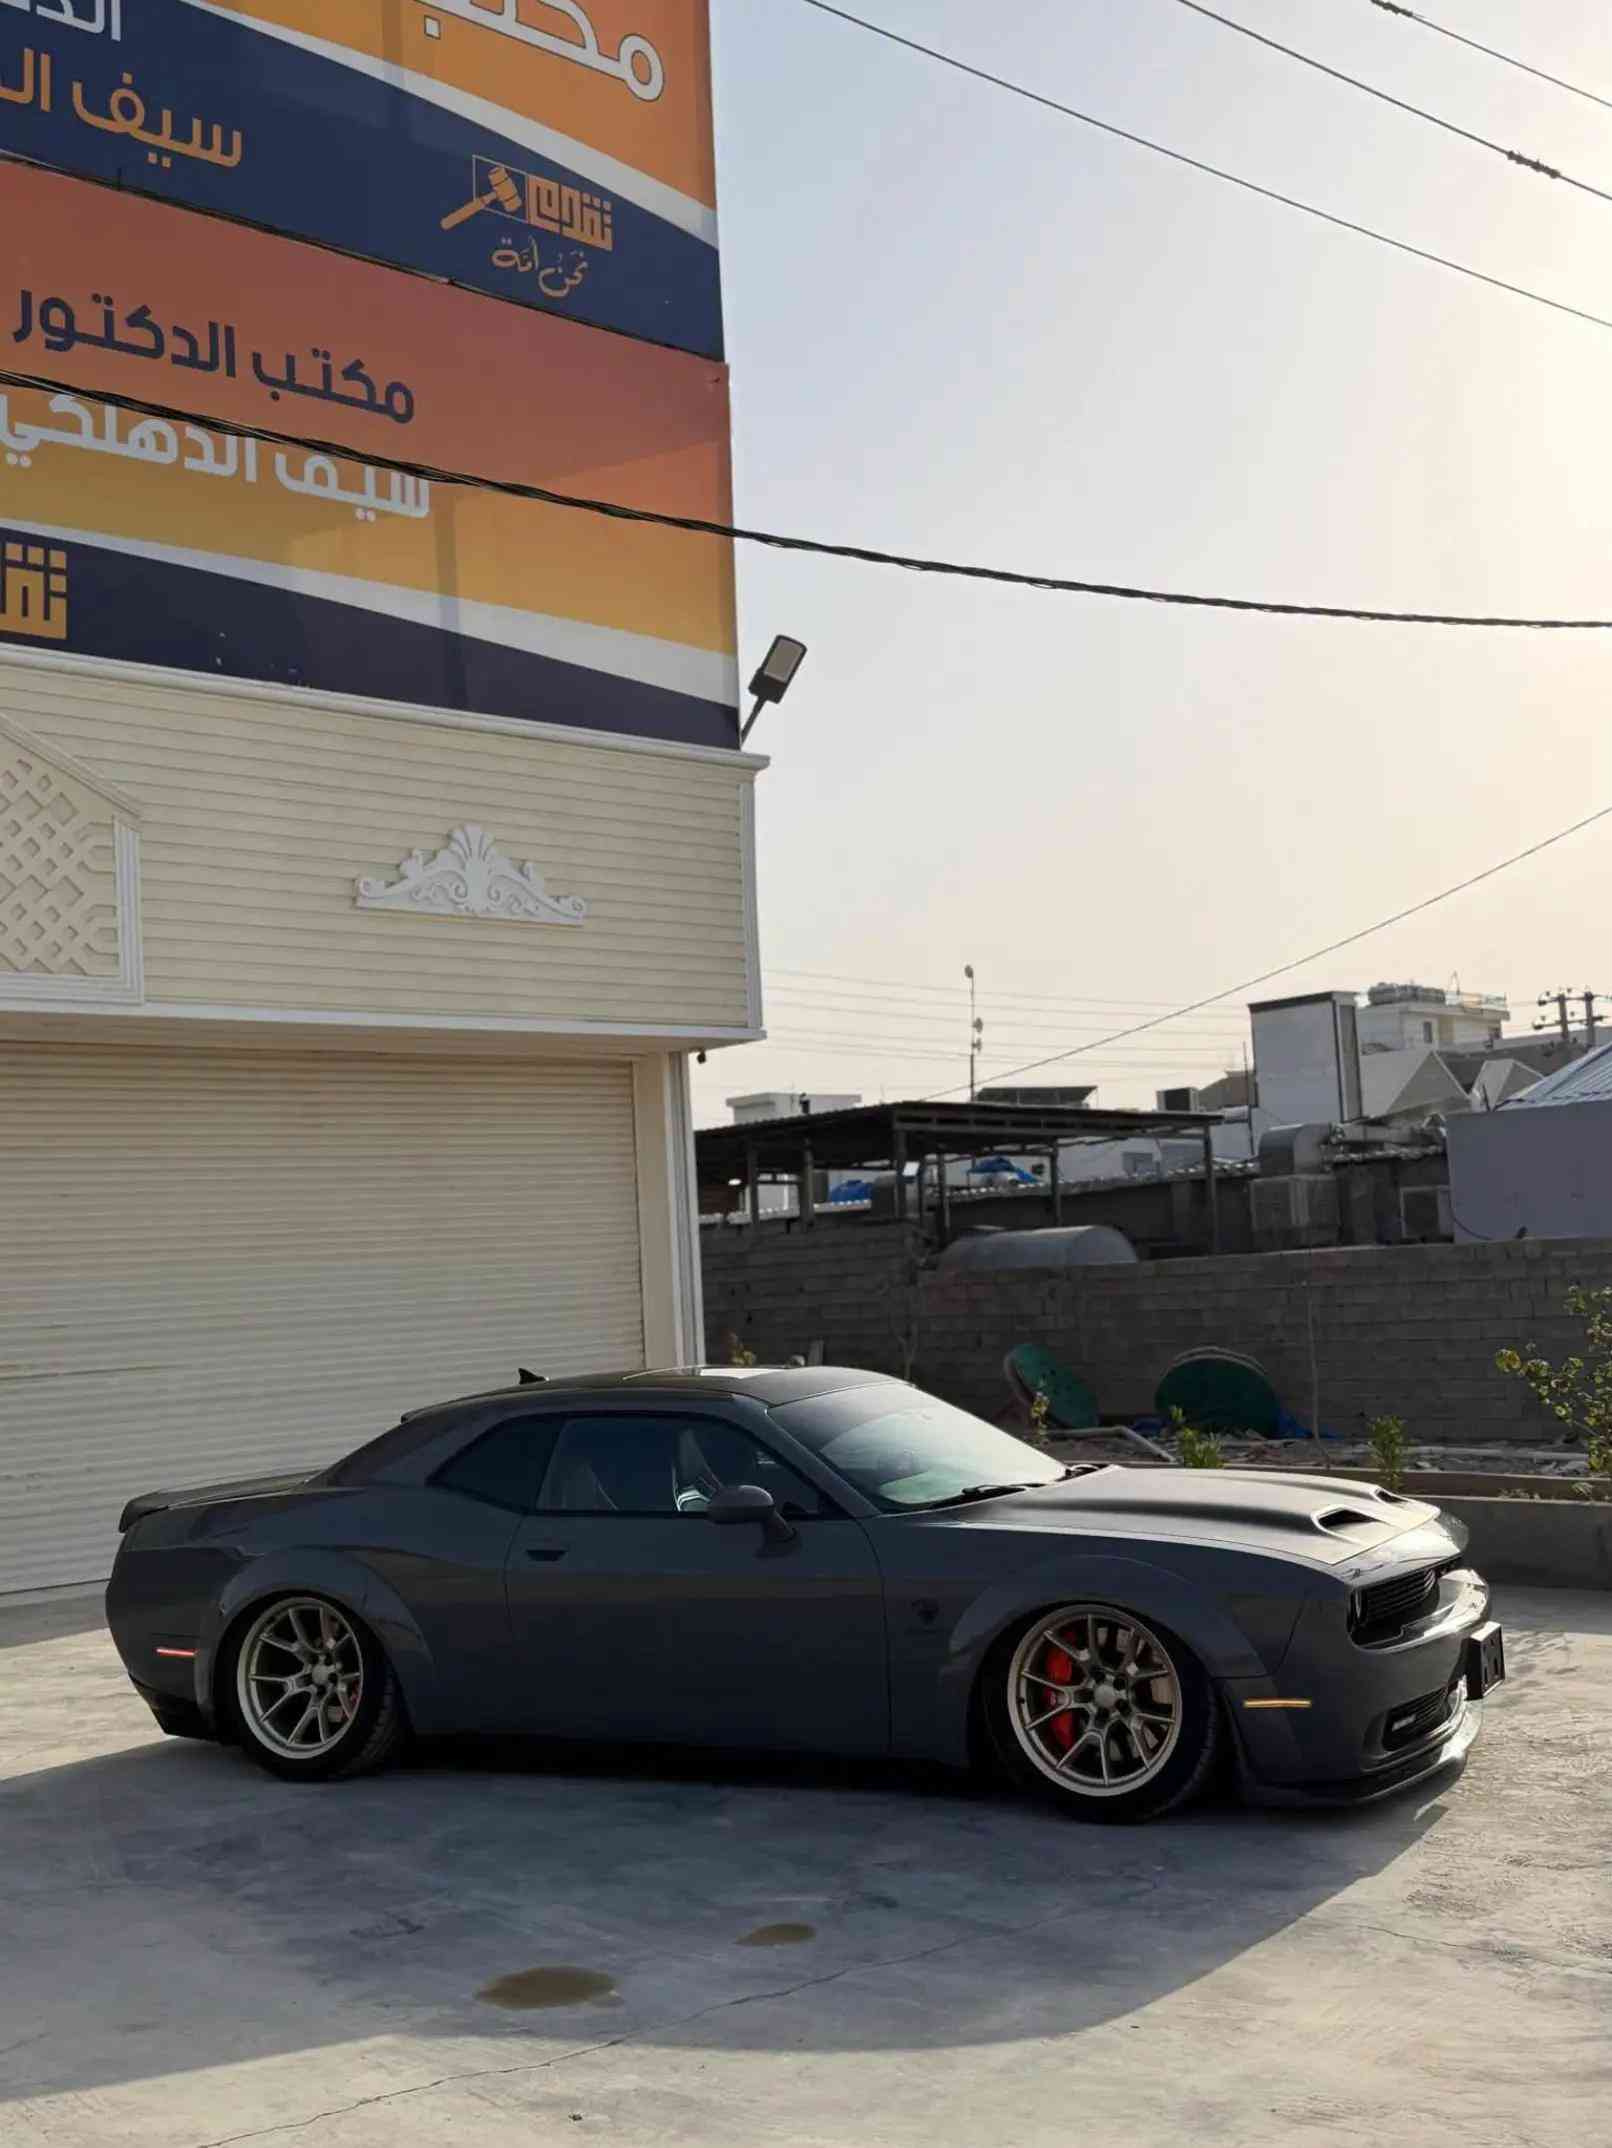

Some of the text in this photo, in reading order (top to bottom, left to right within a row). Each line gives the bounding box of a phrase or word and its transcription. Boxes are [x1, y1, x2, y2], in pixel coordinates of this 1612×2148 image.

[72, 72, 243, 168] سيف
[12, 289, 415, 424] مكتب الدكتور
[274, 451, 430, 522] سيف
